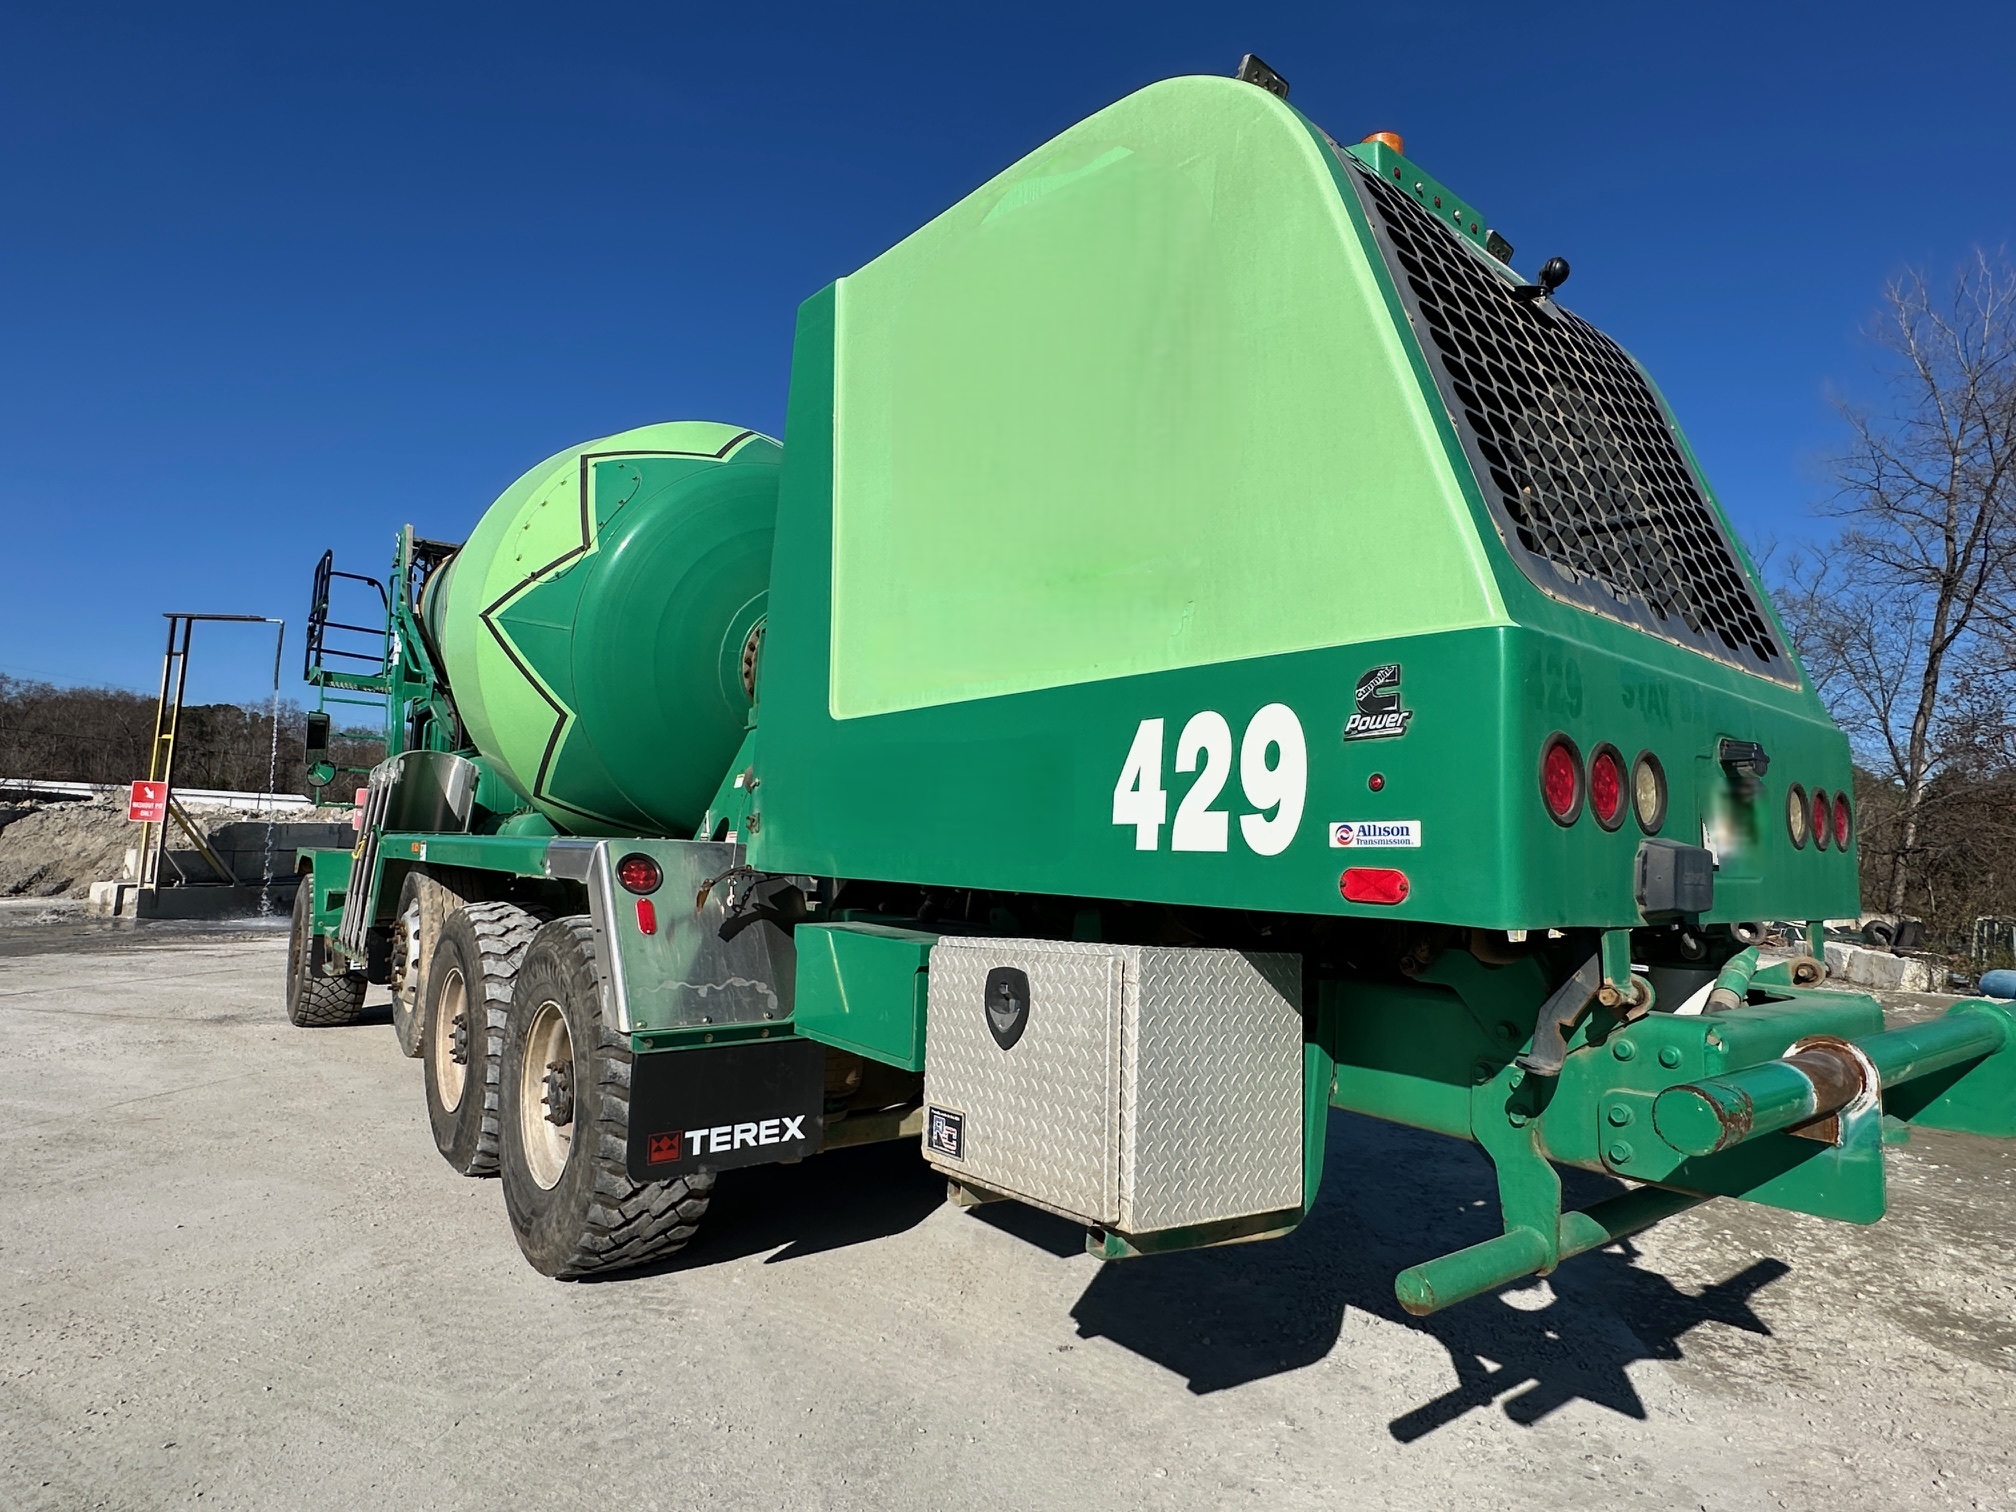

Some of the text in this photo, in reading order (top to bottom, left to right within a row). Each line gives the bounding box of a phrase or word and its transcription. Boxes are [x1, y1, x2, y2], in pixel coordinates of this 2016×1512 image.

[1356, 667, 1395, 700] Cummins
[1345, 712, 1409, 732] Power
[1112, 702, 1308, 857] 429
[1356, 824, 1410, 837] Allison
[1356, 838, 1411, 846] Transmission
[685, 1114, 806, 1156] TEREX
